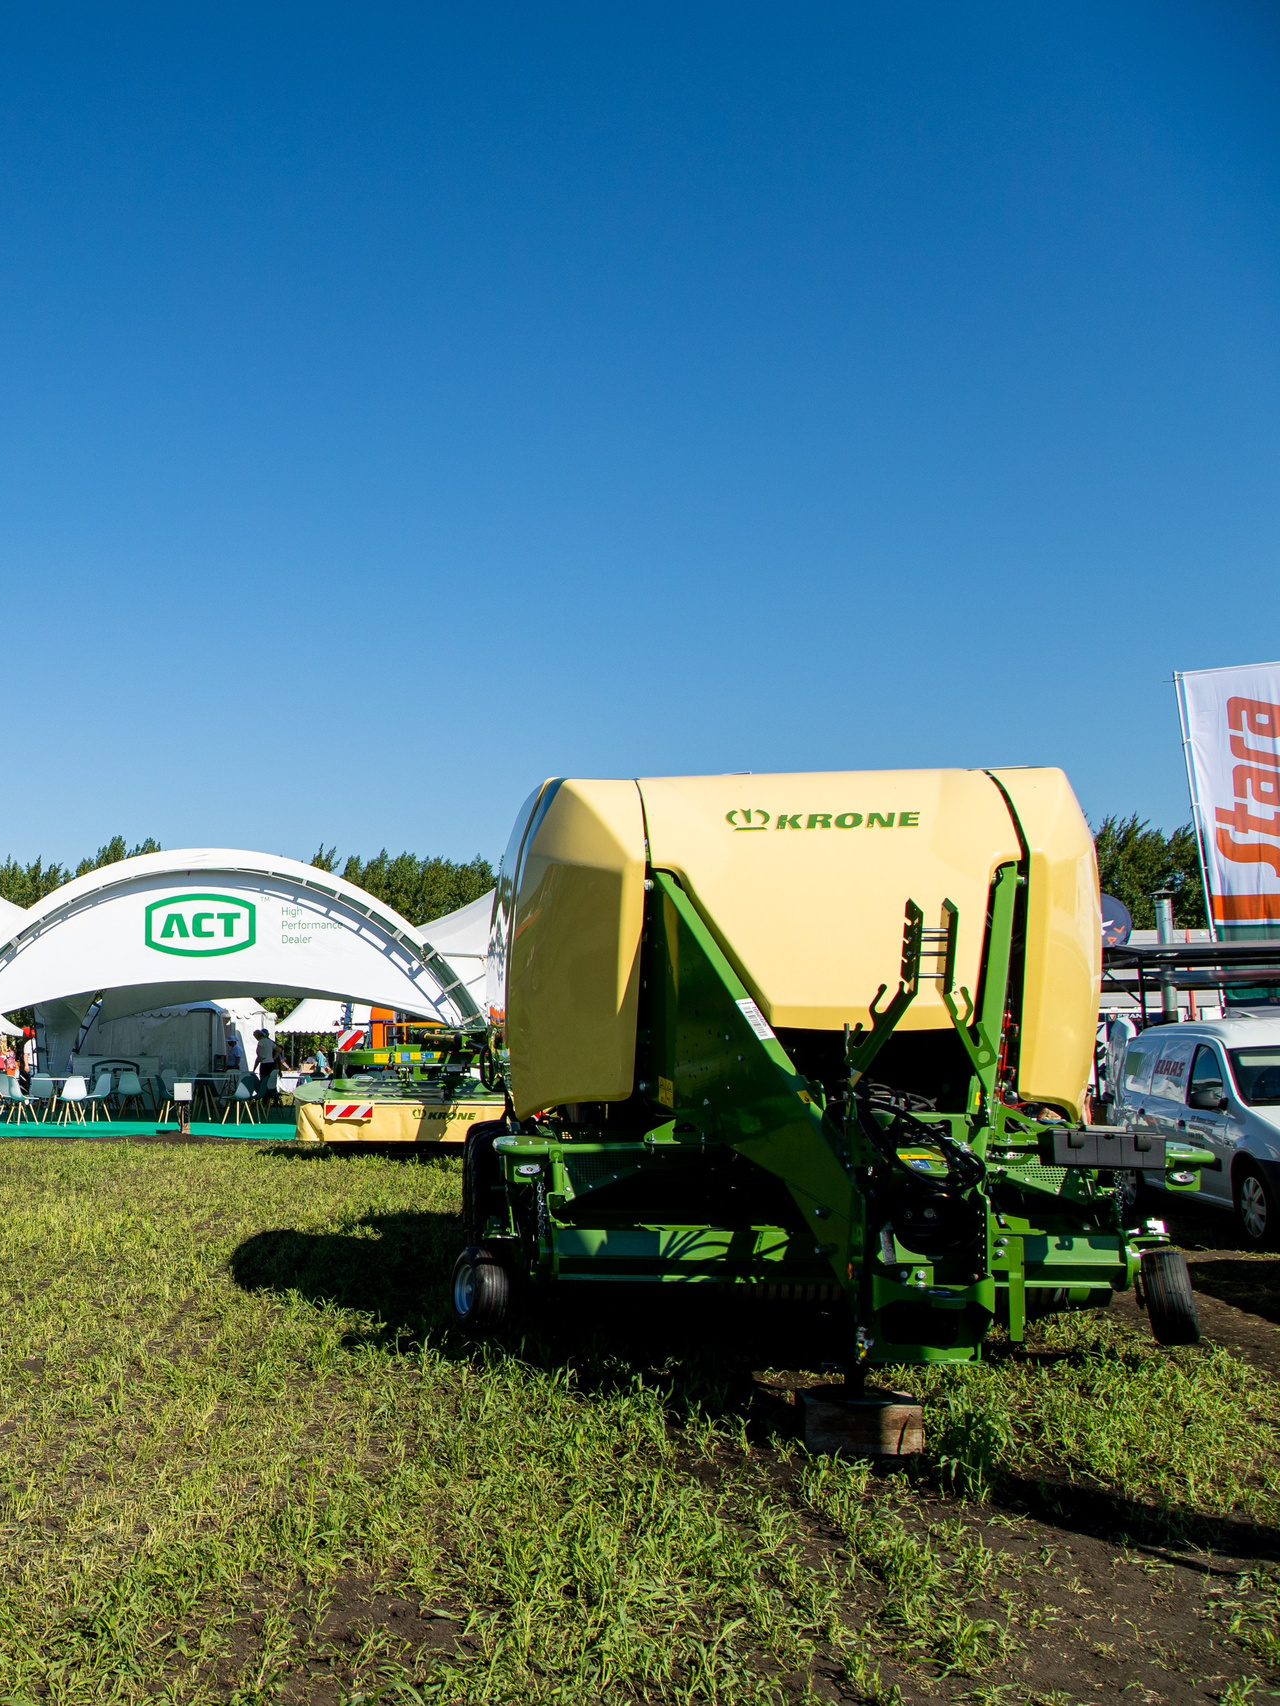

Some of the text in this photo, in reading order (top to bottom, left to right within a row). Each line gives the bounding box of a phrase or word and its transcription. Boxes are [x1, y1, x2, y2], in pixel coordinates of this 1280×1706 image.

[1215, 696, 1280, 878] Stara
[775, 811, 920, 830] KRONE
[281, 906, 303, 918] High
[159, 912, 241, 938] ACT
[281, 920, 343, 930] Performance
[281, 934, 313, 944] Dealer
[1155, 1059, 1186, 1077] CLAAS
[427, 1112, 476, 1120] KRONE
